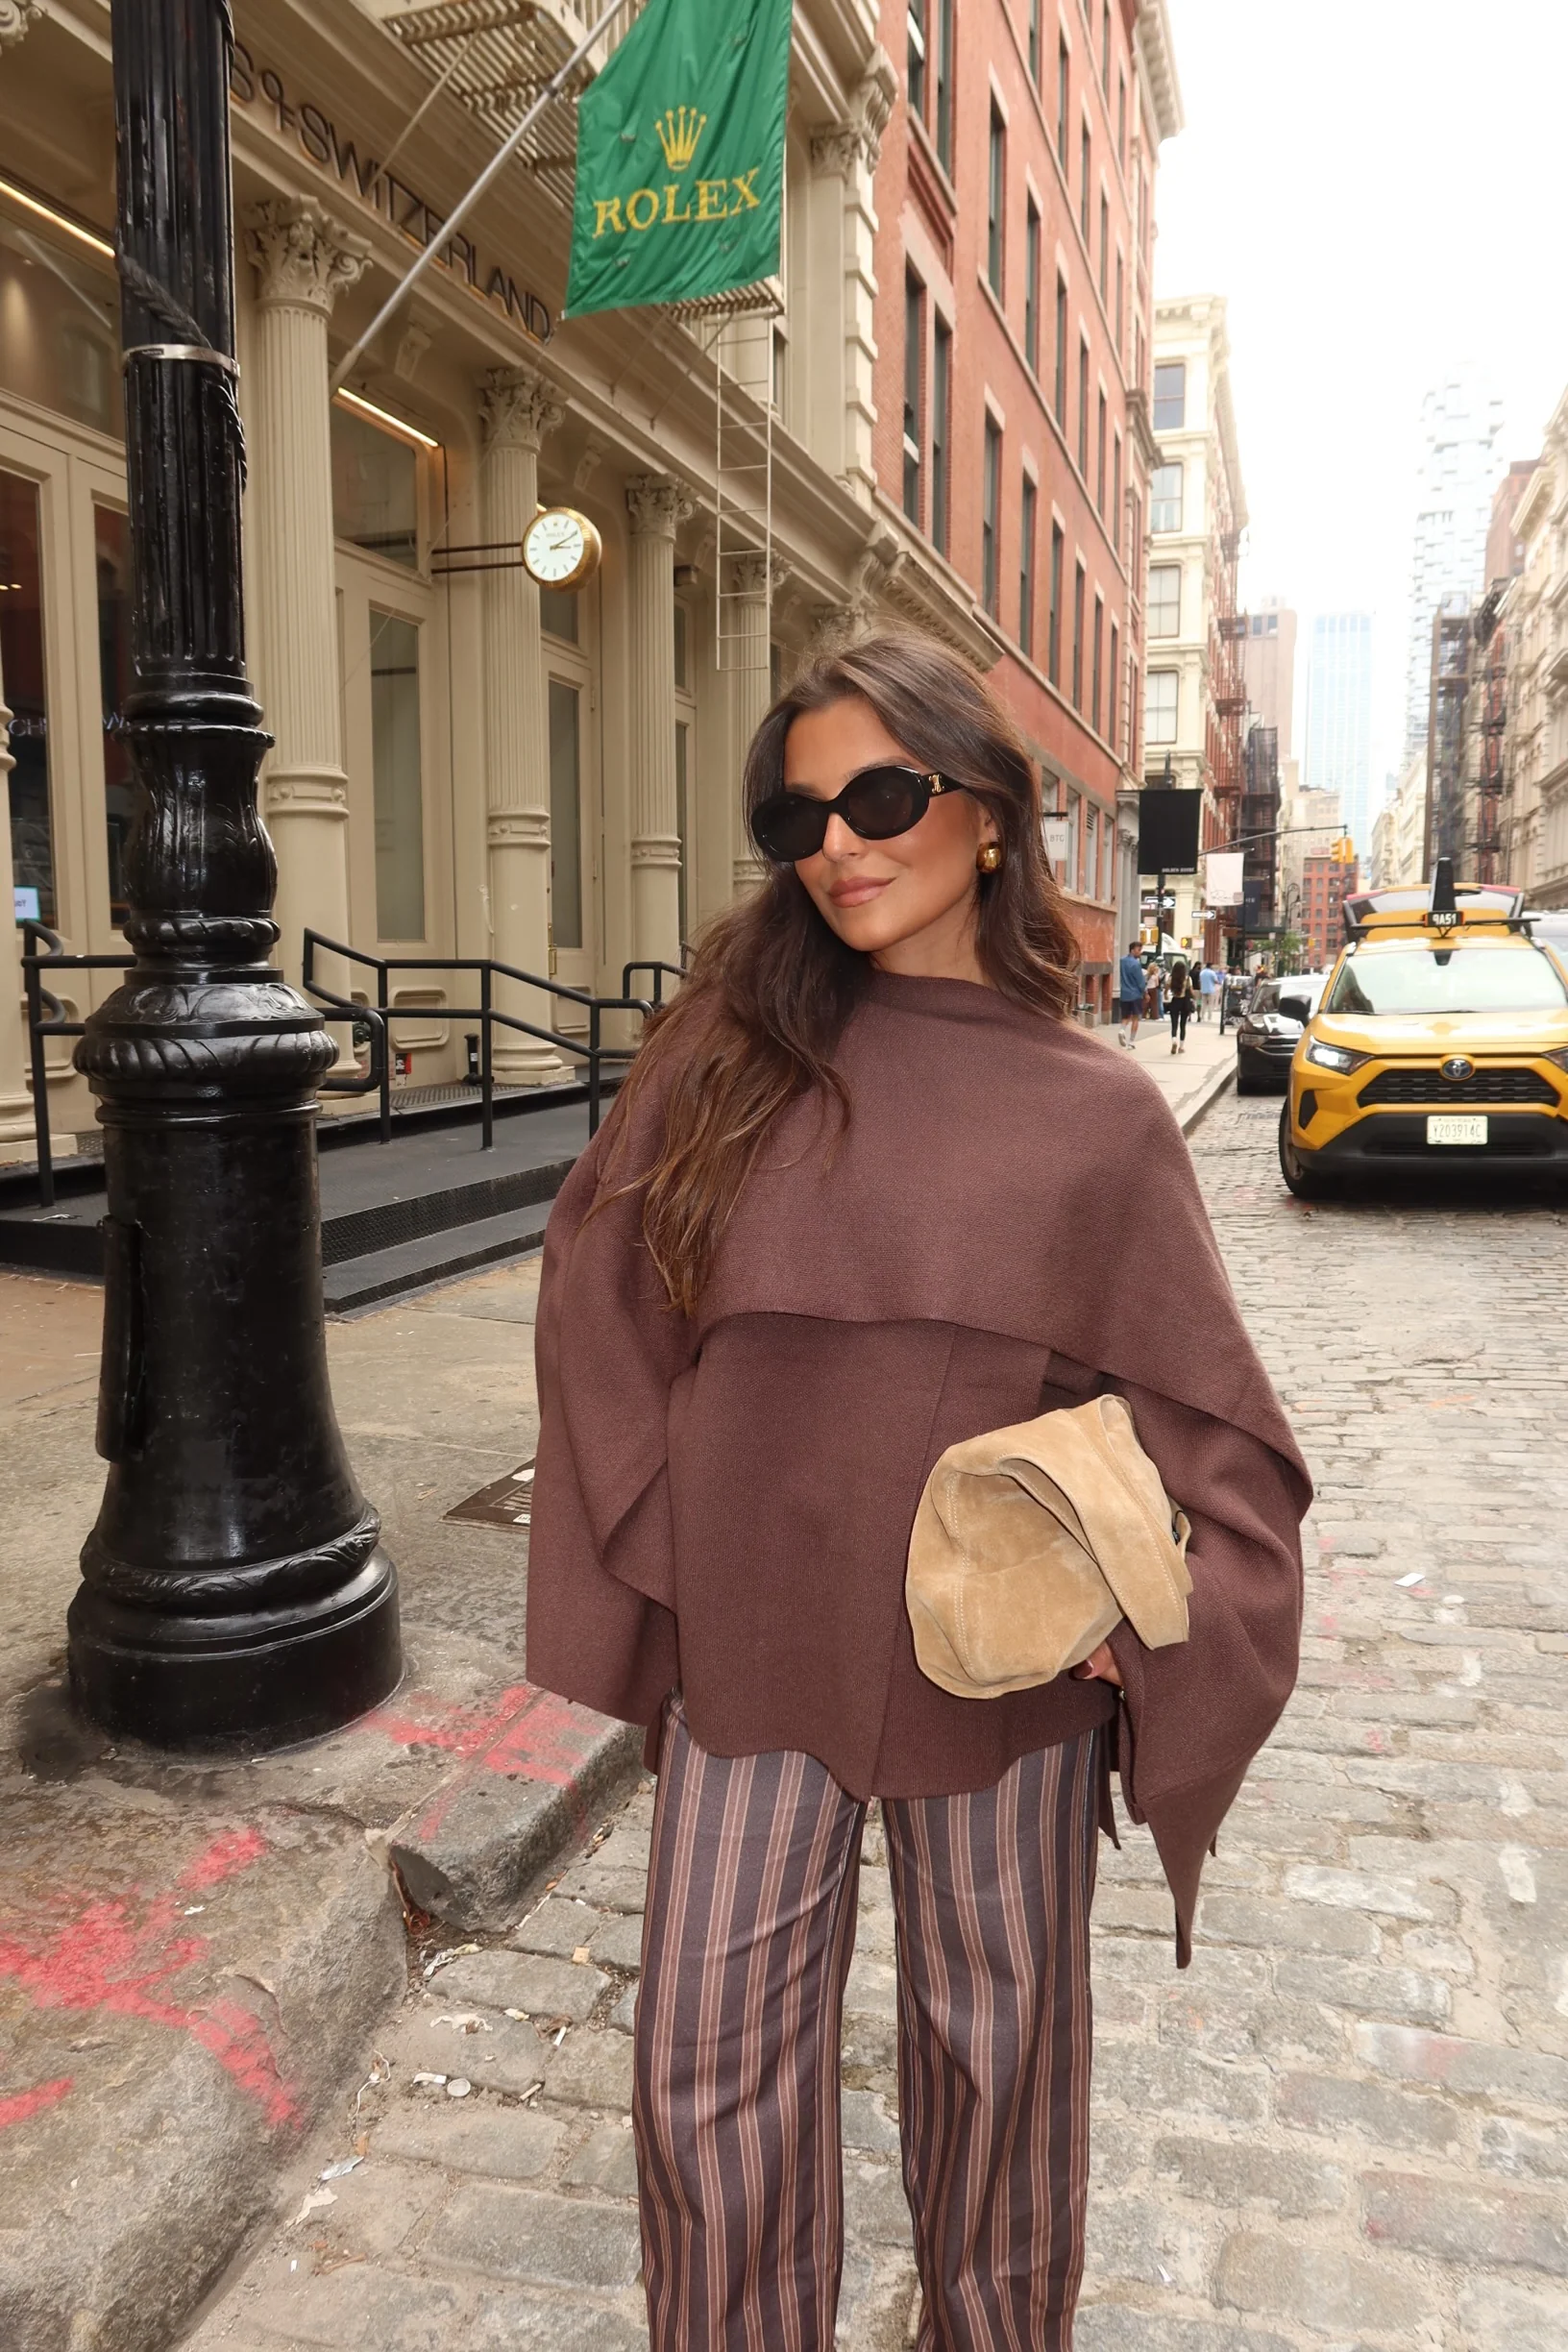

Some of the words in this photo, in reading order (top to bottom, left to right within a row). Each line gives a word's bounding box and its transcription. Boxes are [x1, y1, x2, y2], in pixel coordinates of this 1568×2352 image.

[299, 103, 551, 342] SWITZERLAND
[592, 167, 760, 239] ROLEX
[1432, 913, 1457, 925] 9A51
